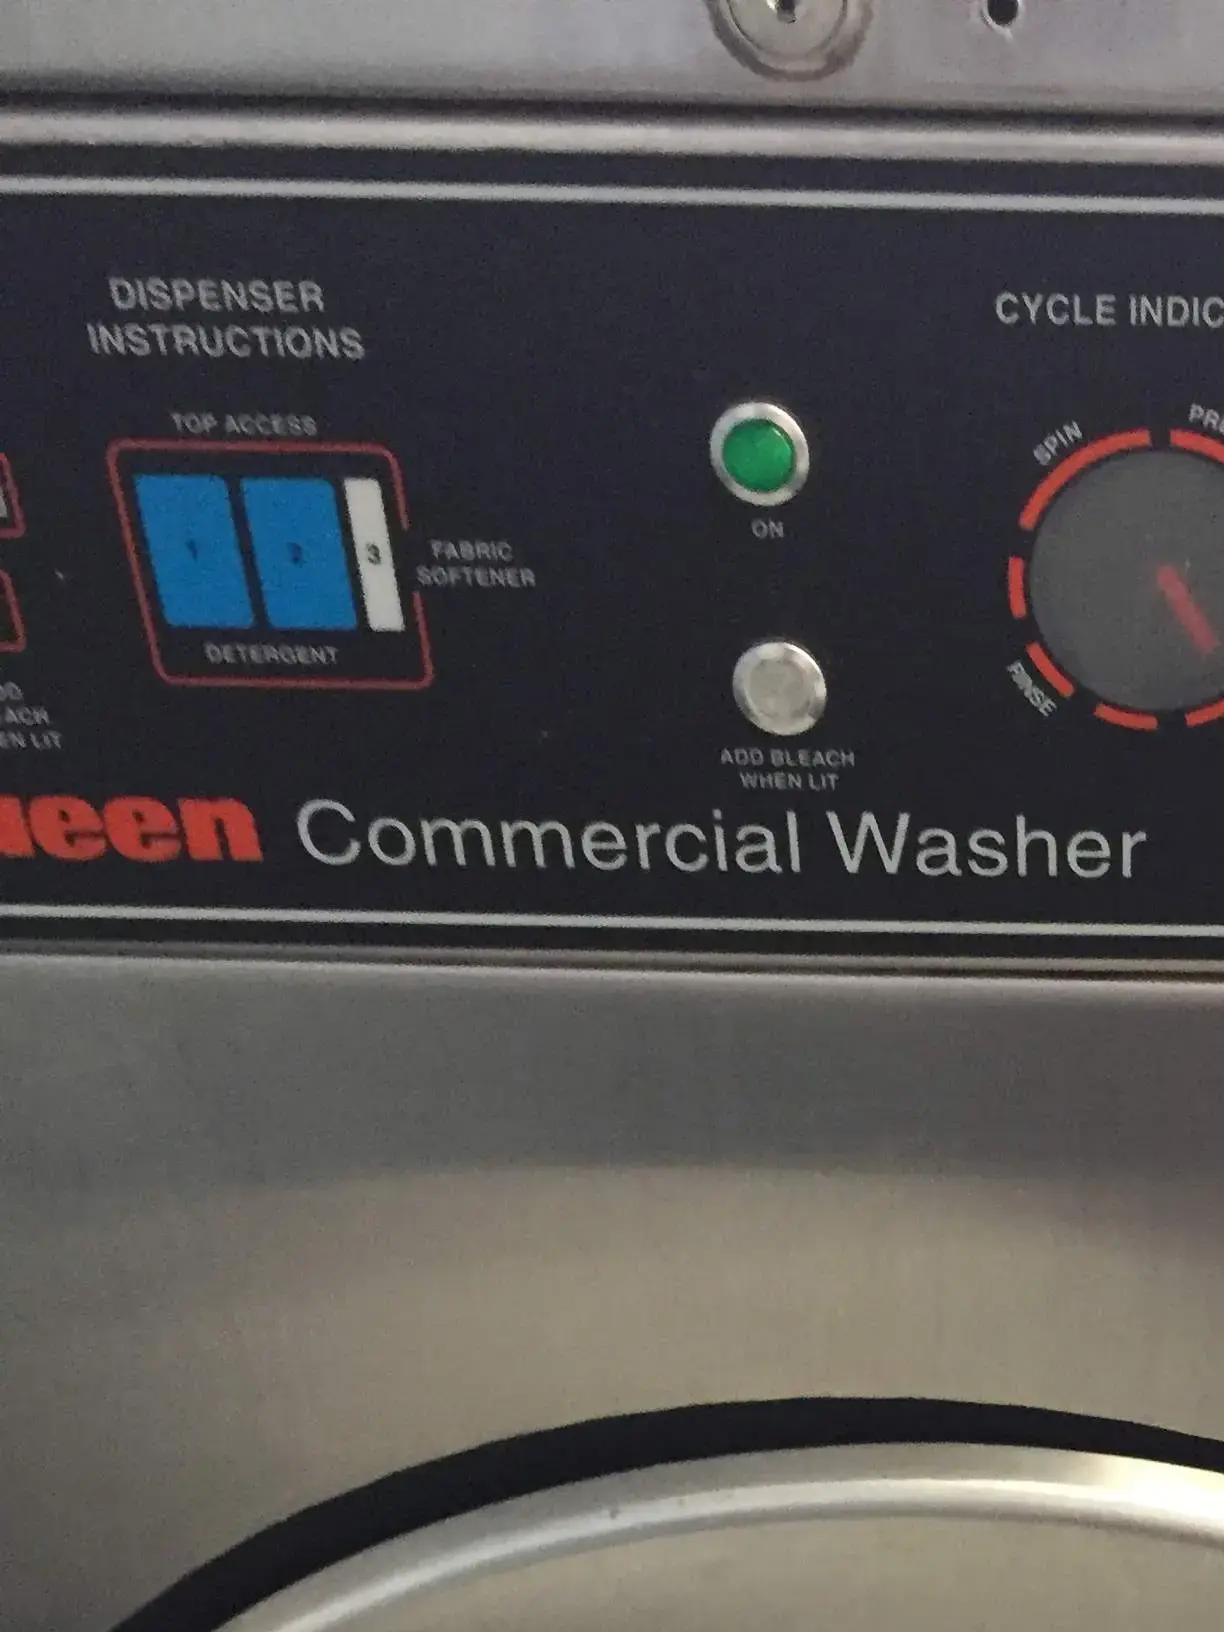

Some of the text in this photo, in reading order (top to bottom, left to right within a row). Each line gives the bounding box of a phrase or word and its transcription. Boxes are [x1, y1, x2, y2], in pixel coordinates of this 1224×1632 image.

[109, 277, 325, 313] DISPENSER
[995, 292, 1116, 327] CYCLE
[87, 322, 365, 361] INSTRUCTIONS
[172, 411, 317, 437] TOP ACCESS
[1033, 420, 1083, 466] SPIN
[751, 519, 785, 539] ON
[365, 542, 383, 566] 3
[430, 539, 513, 563] FABRIC
[416, 566, 536, 589] SOFTENER
[204, 641, 339, 667] DETERGENT
[720, 748, 855, 768] ADD BLEACH
[740, 772, 839, 790] WHEN LIT
[296, 798, 1148, 879] Commercial Washer
